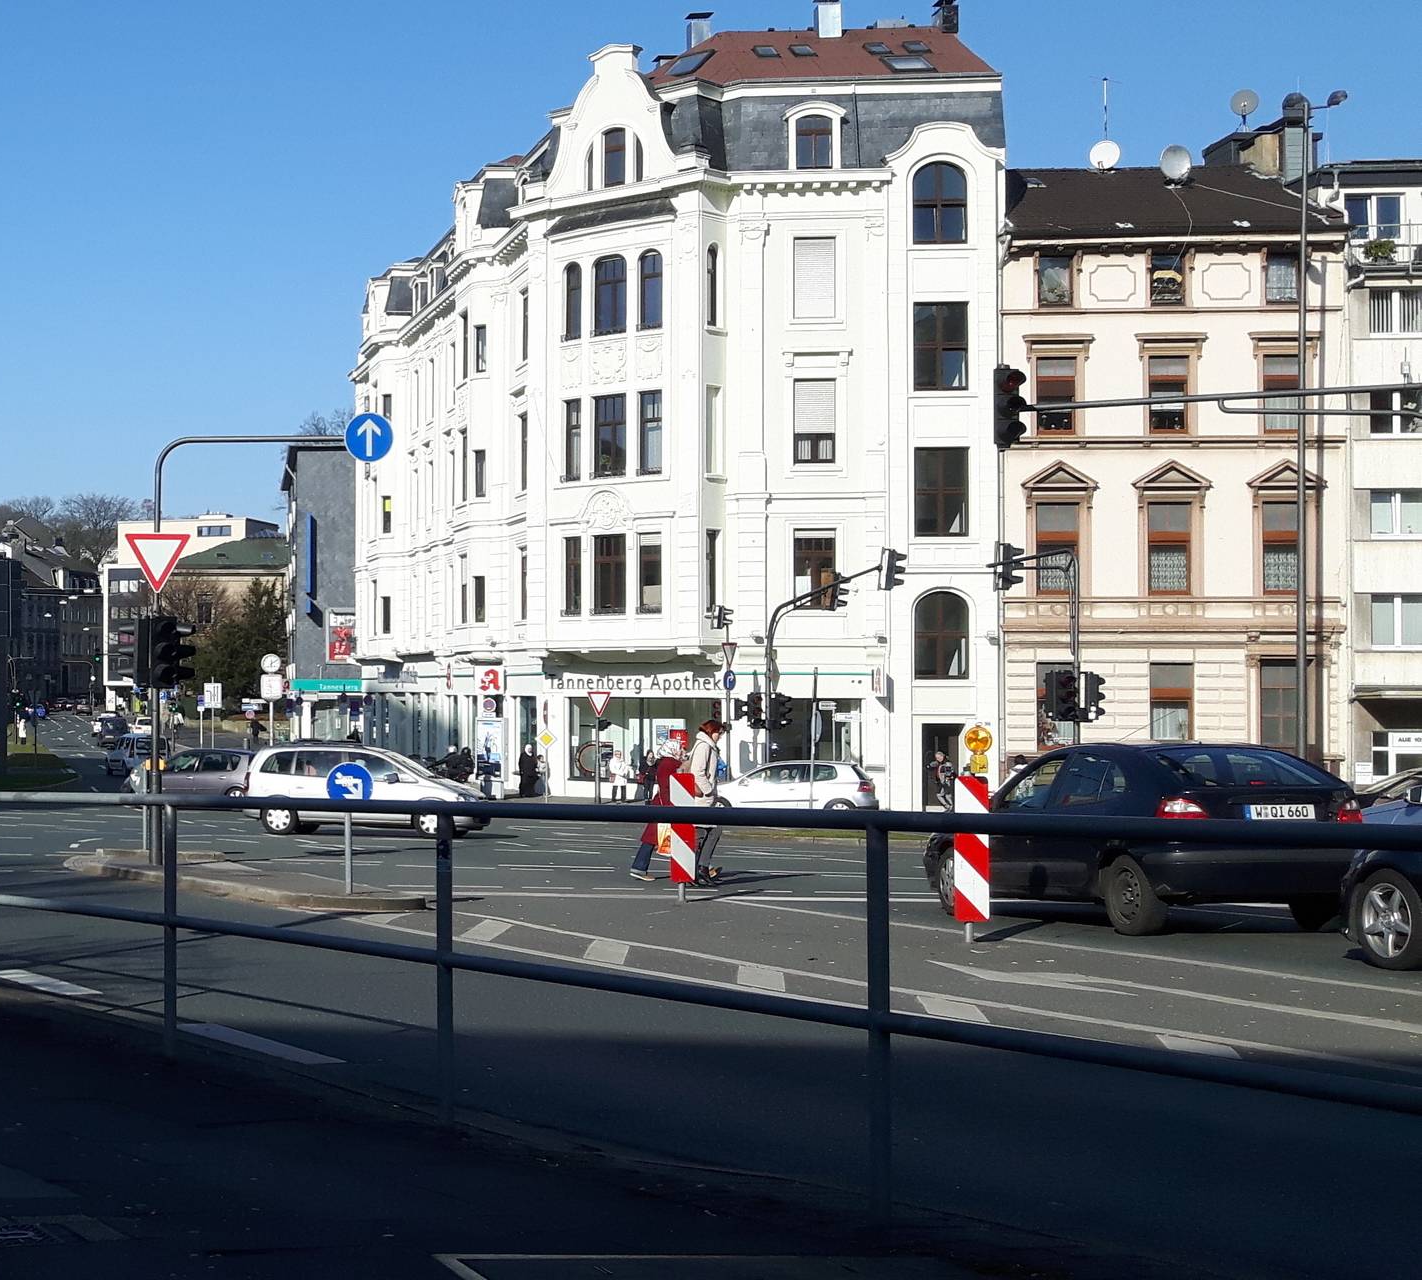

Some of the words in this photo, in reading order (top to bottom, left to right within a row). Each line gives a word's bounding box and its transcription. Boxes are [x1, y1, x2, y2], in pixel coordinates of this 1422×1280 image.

[549, 675, 642, 695] Tannenberg
[650, 675, 722, 694] Apothek
[1254, 806, 1263, 818] W
[1270, 806, 1285, 818] QI
[1287, 805, 1309, 818] 660
